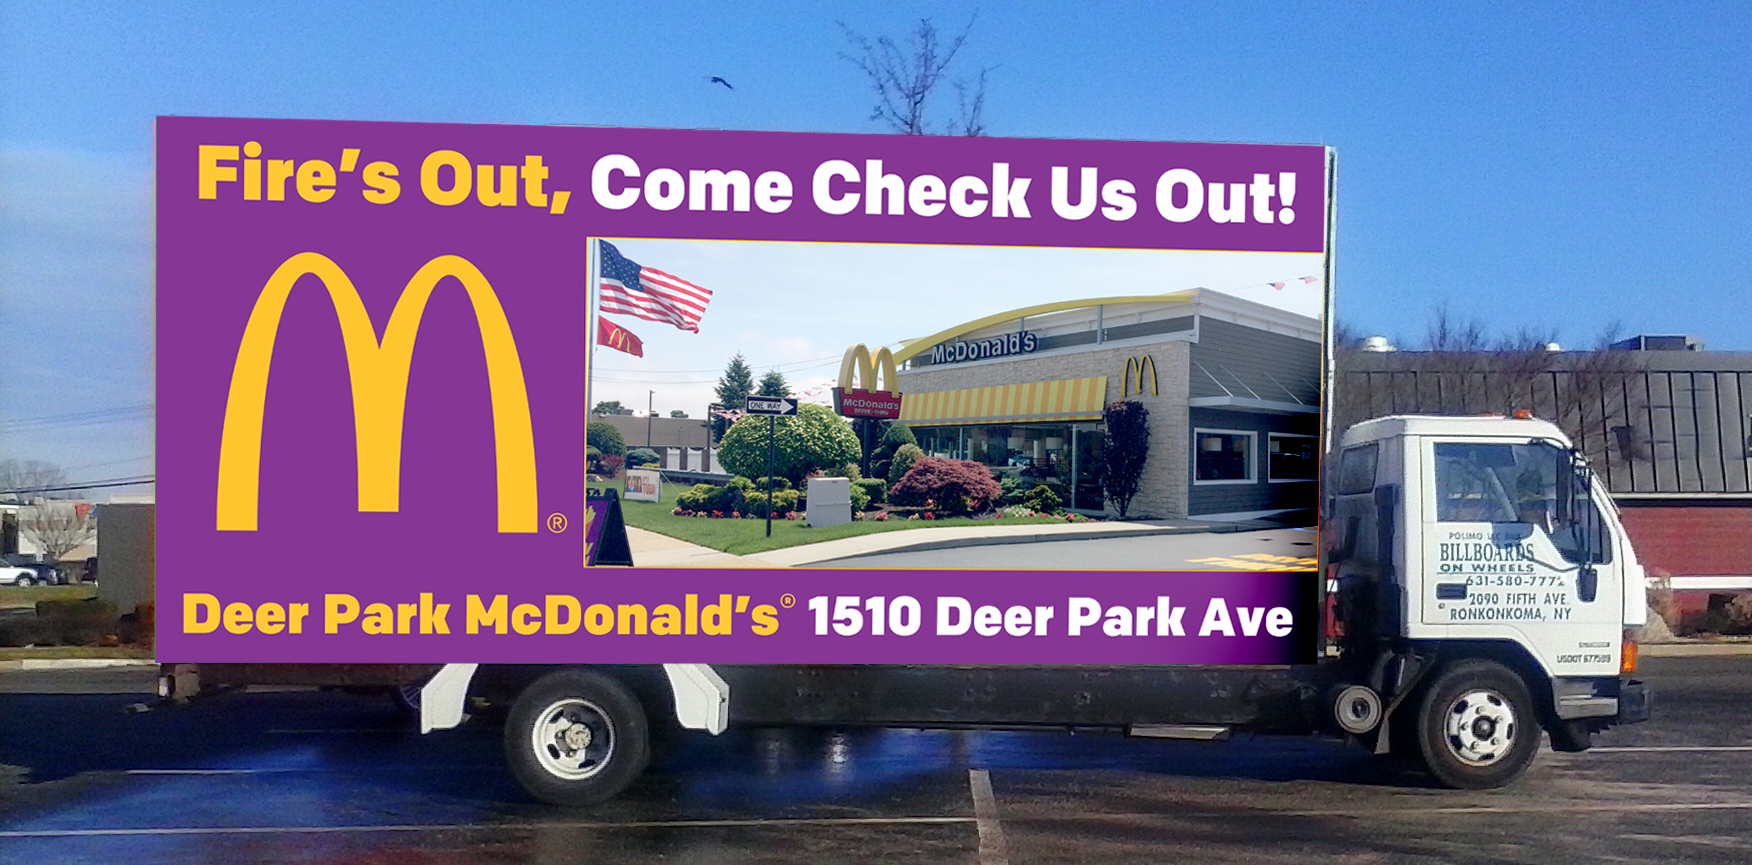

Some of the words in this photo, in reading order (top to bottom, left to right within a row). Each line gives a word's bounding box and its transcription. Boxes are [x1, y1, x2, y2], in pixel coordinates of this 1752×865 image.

[199, 141, 401, 205] Fire's
[421, 150, 572, 215] Out,
[591, 155, 793, 214] Come
[812, 160, 1032, 219] Check
[1050, 166, 1138, 222] Us
[1155, 169, 1297, 225] Out!
[931, 330, 1038, 365] McDonald's
[750, 401, 765, 410] ONE
[766, 401, 782, 410] WAY
[843, 398, 899, 410] McDonald's
[1440, 543, 1535, 561] BILLBOARDS
[1440, 564, 1463, 572] ON
[1472, 564, 1535, 573] WHEELS
[1469, 593, 1499, 605] 2090
[1507, 593, 1536, 605] FIFTH
[183, 594, 308, 635] Deer
[325, 593, 451, 635] Park
[808, 596, 922, 637] 1510
[936, 597, 1055, 637] Deer
[1068, 596, 1187, 637] Park
[1198, 598, 1293, 637] Ave
[1450, 608, 1547, 621] RONKONKOMA,
[1554, 608, 1572, 619] NY
